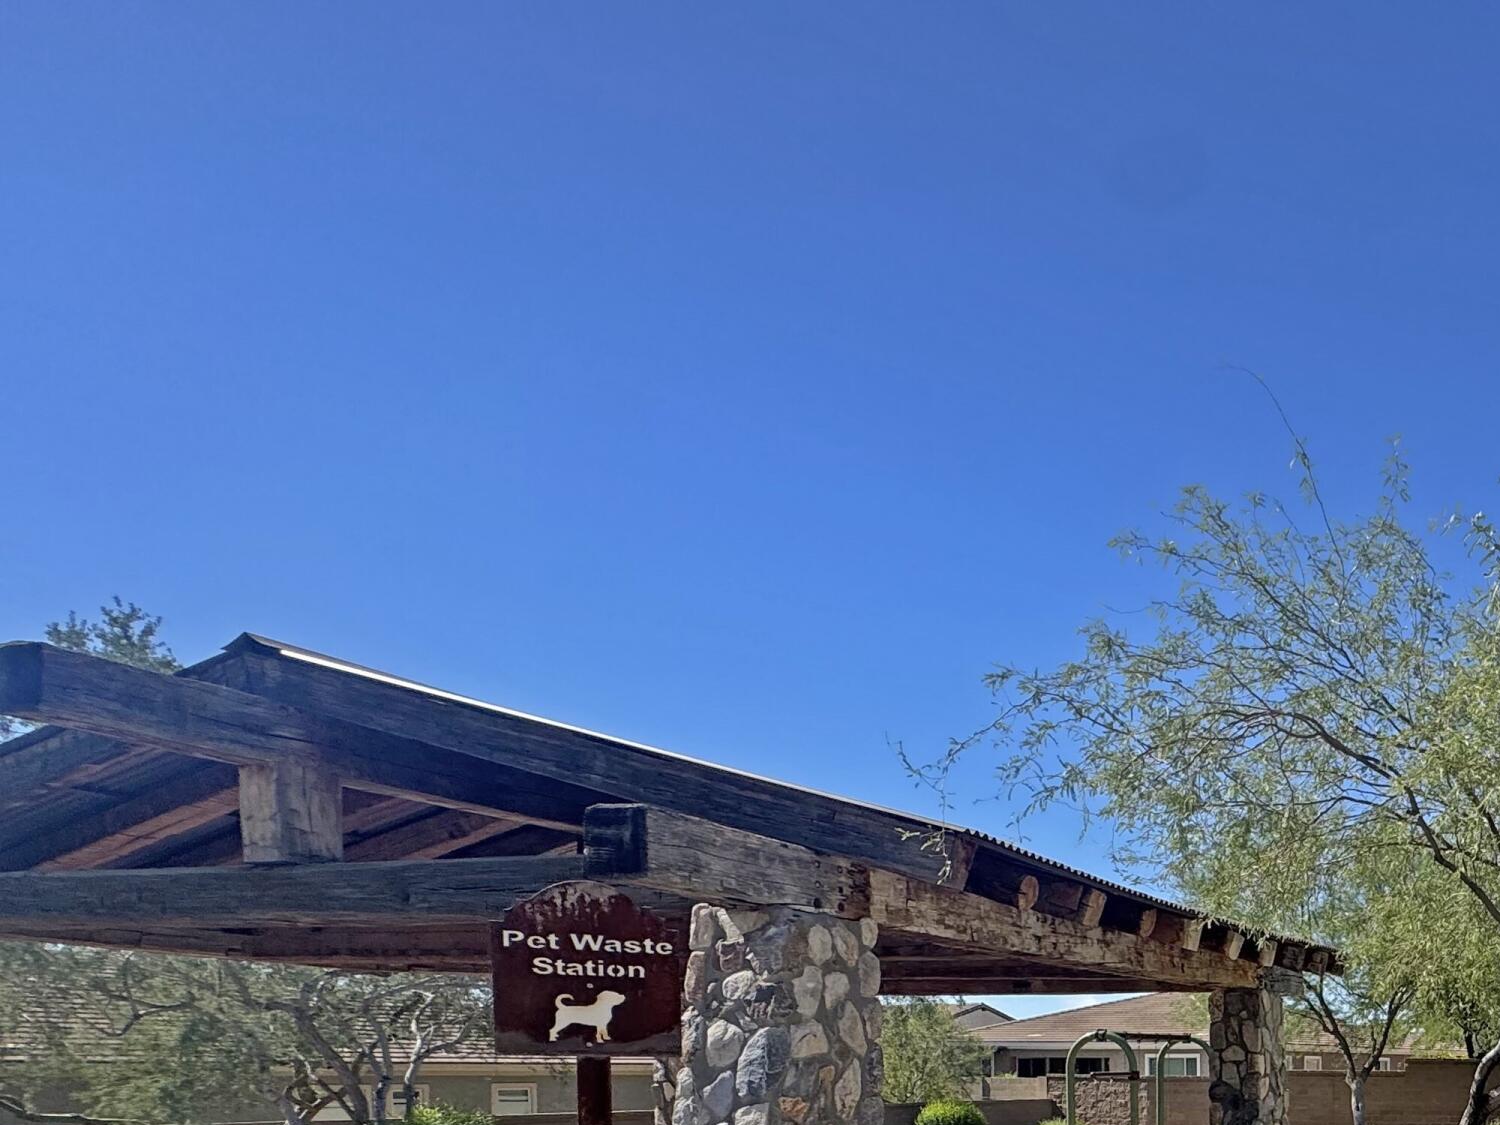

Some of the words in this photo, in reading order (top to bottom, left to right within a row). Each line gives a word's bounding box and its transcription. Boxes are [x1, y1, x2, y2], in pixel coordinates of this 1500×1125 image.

[502, 930, 560, 950] Pet
[569, 933, 673, 955] Waste
[532, 957, 646, 979] Station
